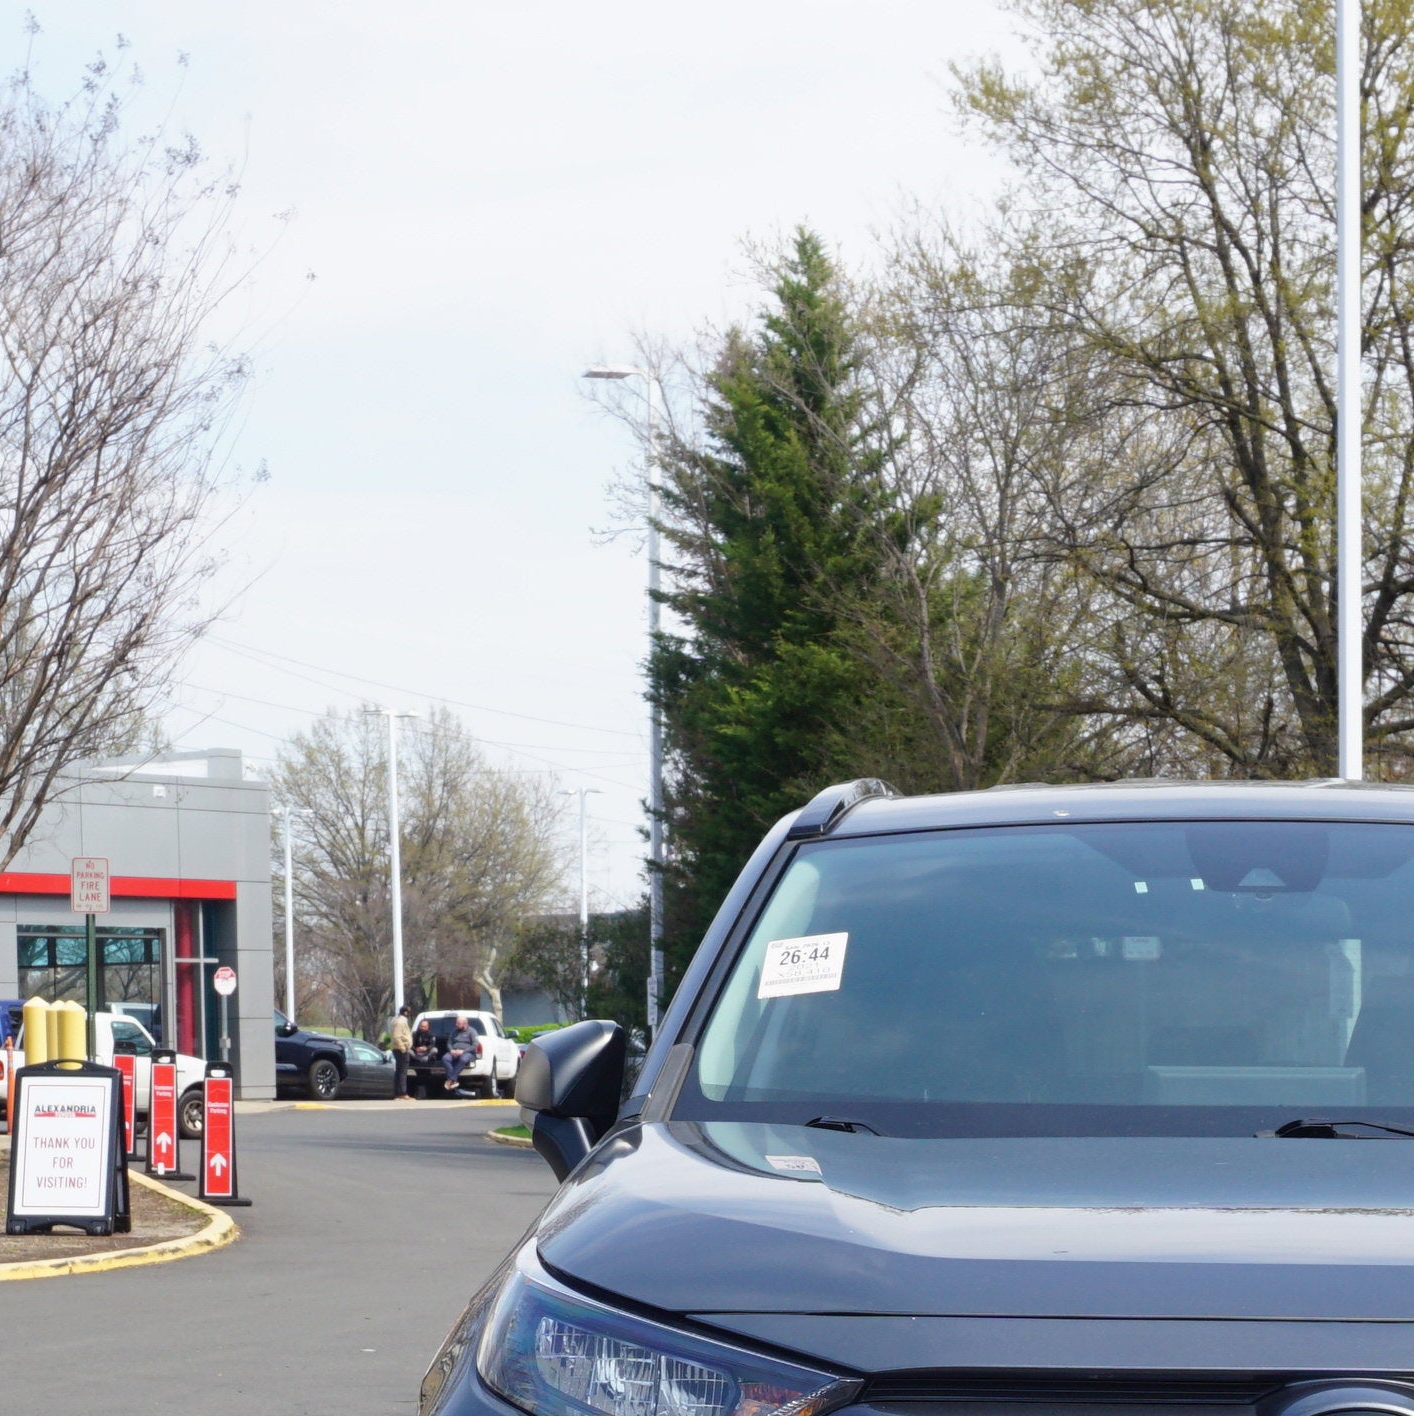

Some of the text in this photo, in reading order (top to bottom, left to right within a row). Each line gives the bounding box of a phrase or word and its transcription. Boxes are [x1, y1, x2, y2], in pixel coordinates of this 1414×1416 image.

[76, 871, 105, 880] PARKING
[80, 881, 100, 891] FIRE
[79, 892, 101, 902] LANE
[779, 946, 830, 966] 26:44
[34, 1104, 96, 1113] ALEXANDRIA
[33, 1136, 96, 1150] THANK YOU
[52, 1156, 74, 1169] FOR
[36, 1176, 88, 1189] VISITING!
